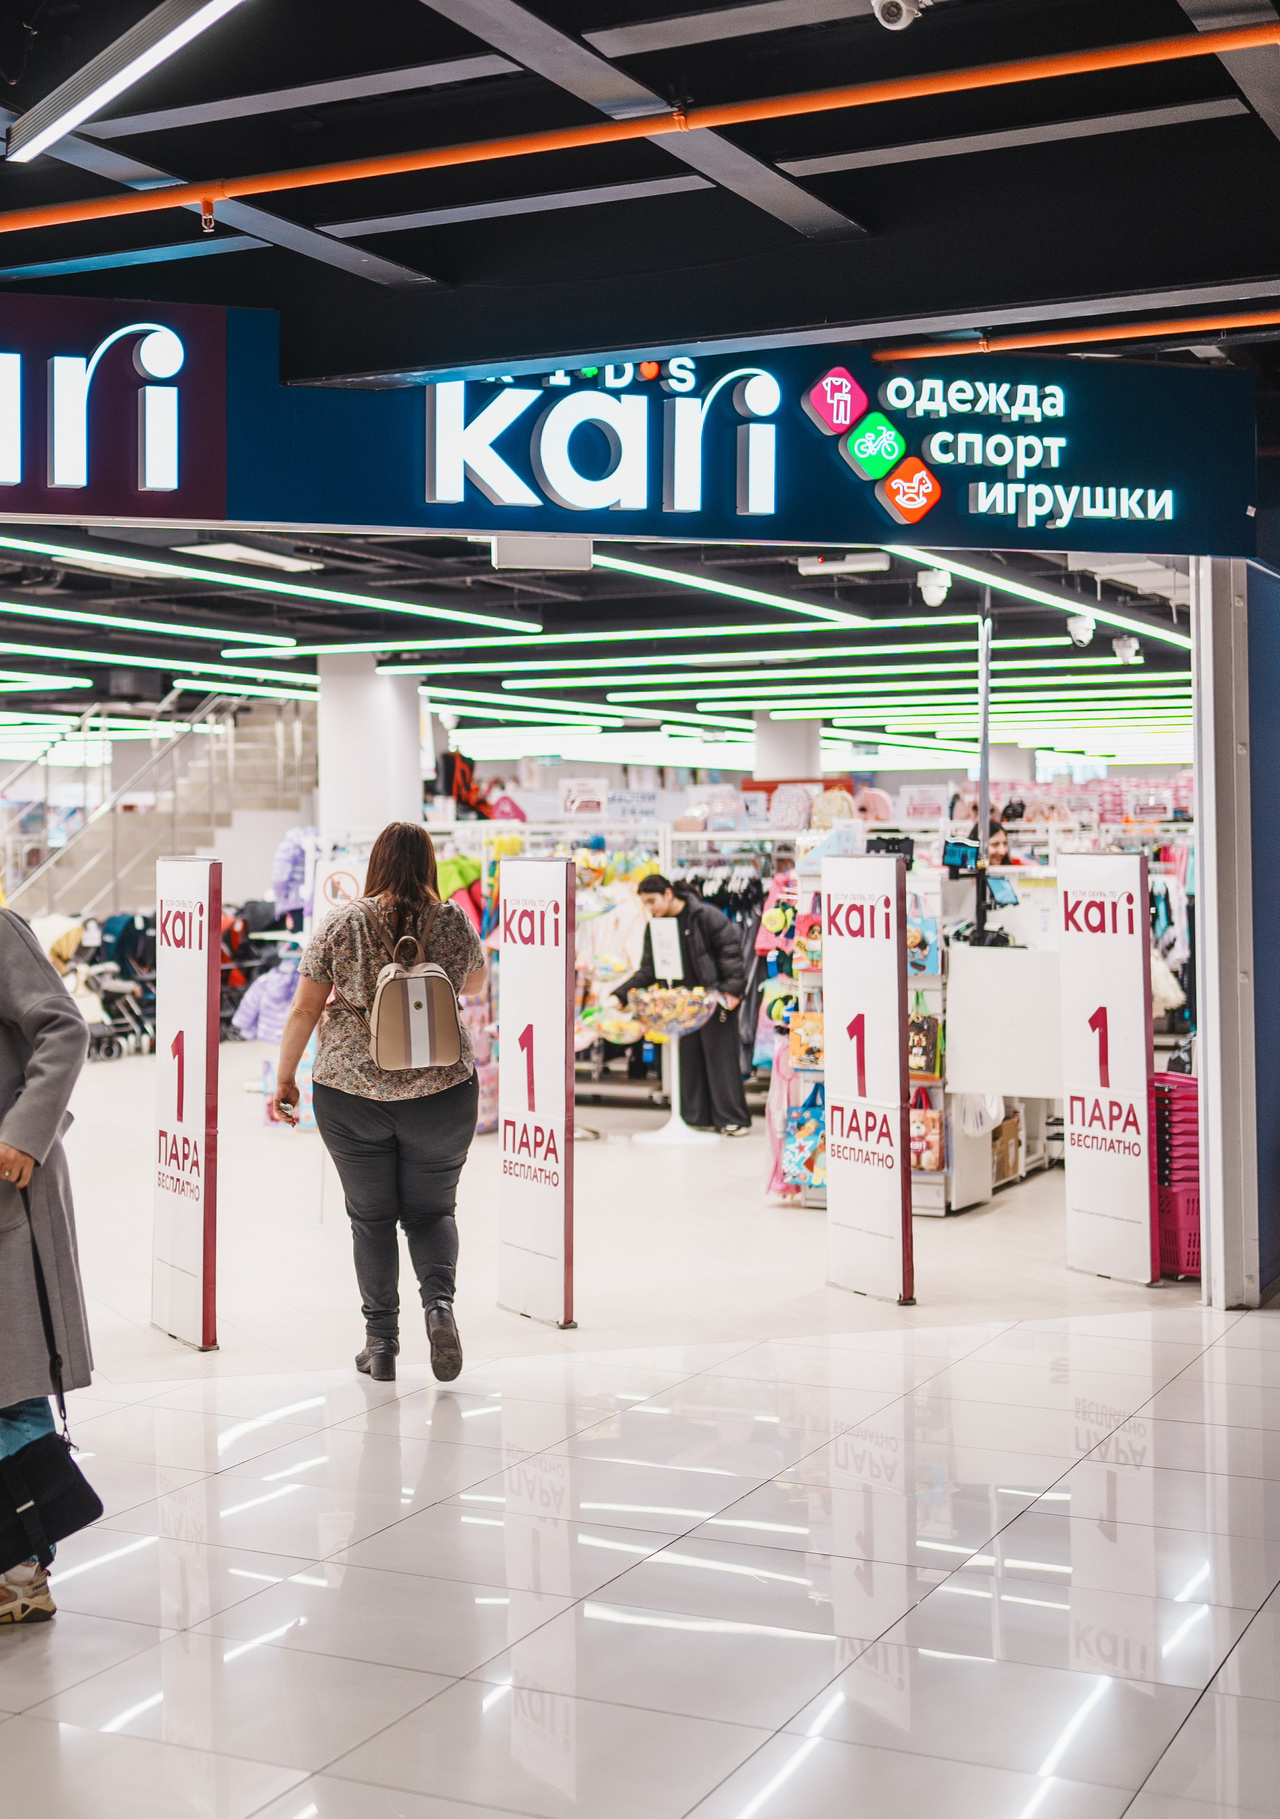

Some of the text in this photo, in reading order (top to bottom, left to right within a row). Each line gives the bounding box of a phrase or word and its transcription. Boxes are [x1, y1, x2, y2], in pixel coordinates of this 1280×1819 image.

[884, 376, 1066, 423] одежда
[428, 367, 781, 515] kari
[928, 431, 1068, 479] спорт
[975, 481, 1174, 528] игрушки
[160, 899, 204, 951] kari
[503, 898, 560, 947] kari
[827, 893, 891, 939] kari
[1063, 890, 1135, 935] kari
[518, 1023, 536, 1112] 1
[846, 1013, 867, 1098] 1
[1088, 1006, 1111, 1089] 1
[171, 1030, 185, 1123] 1
[830, 1105, 894, 1148] ПАРА
[1070, 1095, 1142, 1136] ПАРА
[158, 1129, 201, 1178] ПАРА
[503, 1119, 560, 1165] ПАРА
[830, 1143, 895, 1170] БЕСПЛАТНО
[1070, 1132, 1142, 1158] БЕСПЛАТНО
[157, 1171, 201, 1202] БЕСПЛАТНО
[503, 1159, 560, 1188] БЕСПЛАТНО
